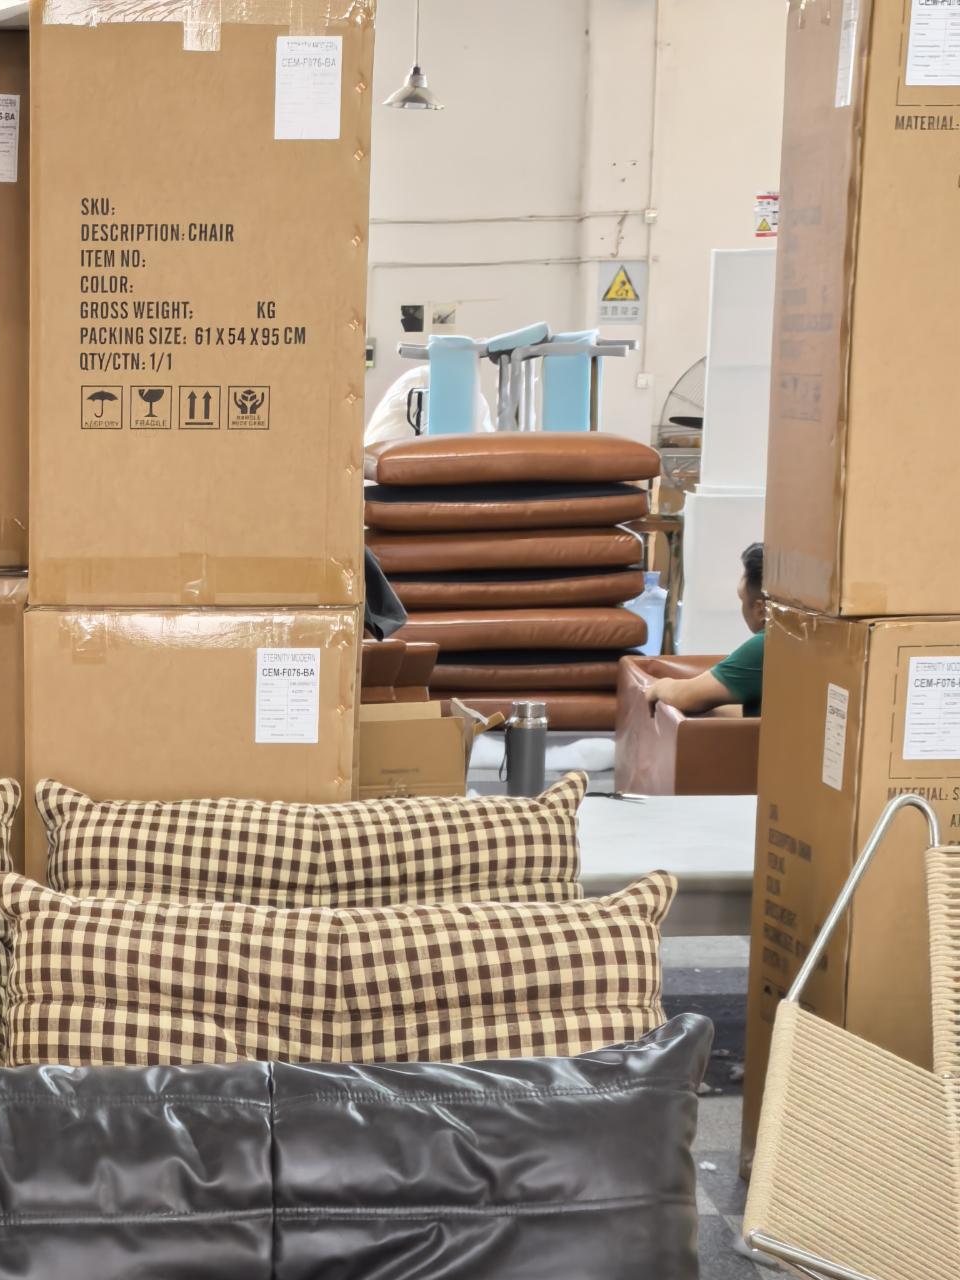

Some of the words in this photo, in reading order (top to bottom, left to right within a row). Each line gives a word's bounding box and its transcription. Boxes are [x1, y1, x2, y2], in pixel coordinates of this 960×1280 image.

[80, 197, 116, 216] SKU:
[188, 223, 234, 242] CHAIR
[80, 249, 115, 268] ITEM
[121, 249, 146, 268] NO:
[80, 275, 134, 293] COLOR:
[80, 301, 128, 320] GROSS
[133, 301, 193, 320] WEIGHT:
[256, 301, 276, 319] KG
[80, 326, 144, 345] PACKING
[149, 326, 187, 345] SIZE:
[194, 326, 211, 345] 61
[228, 327, 246, 345] 54
[262, 327, 280, 346] 95
[283, 326, 306, 345] CM
[79, 351, 146, 372] QTY/CTN:
[149, 351, 172, 373] 1/1
[262, 668, 315, 677] CEM-F076-BA
[913, 678, 960, 688] CEM-F076-
